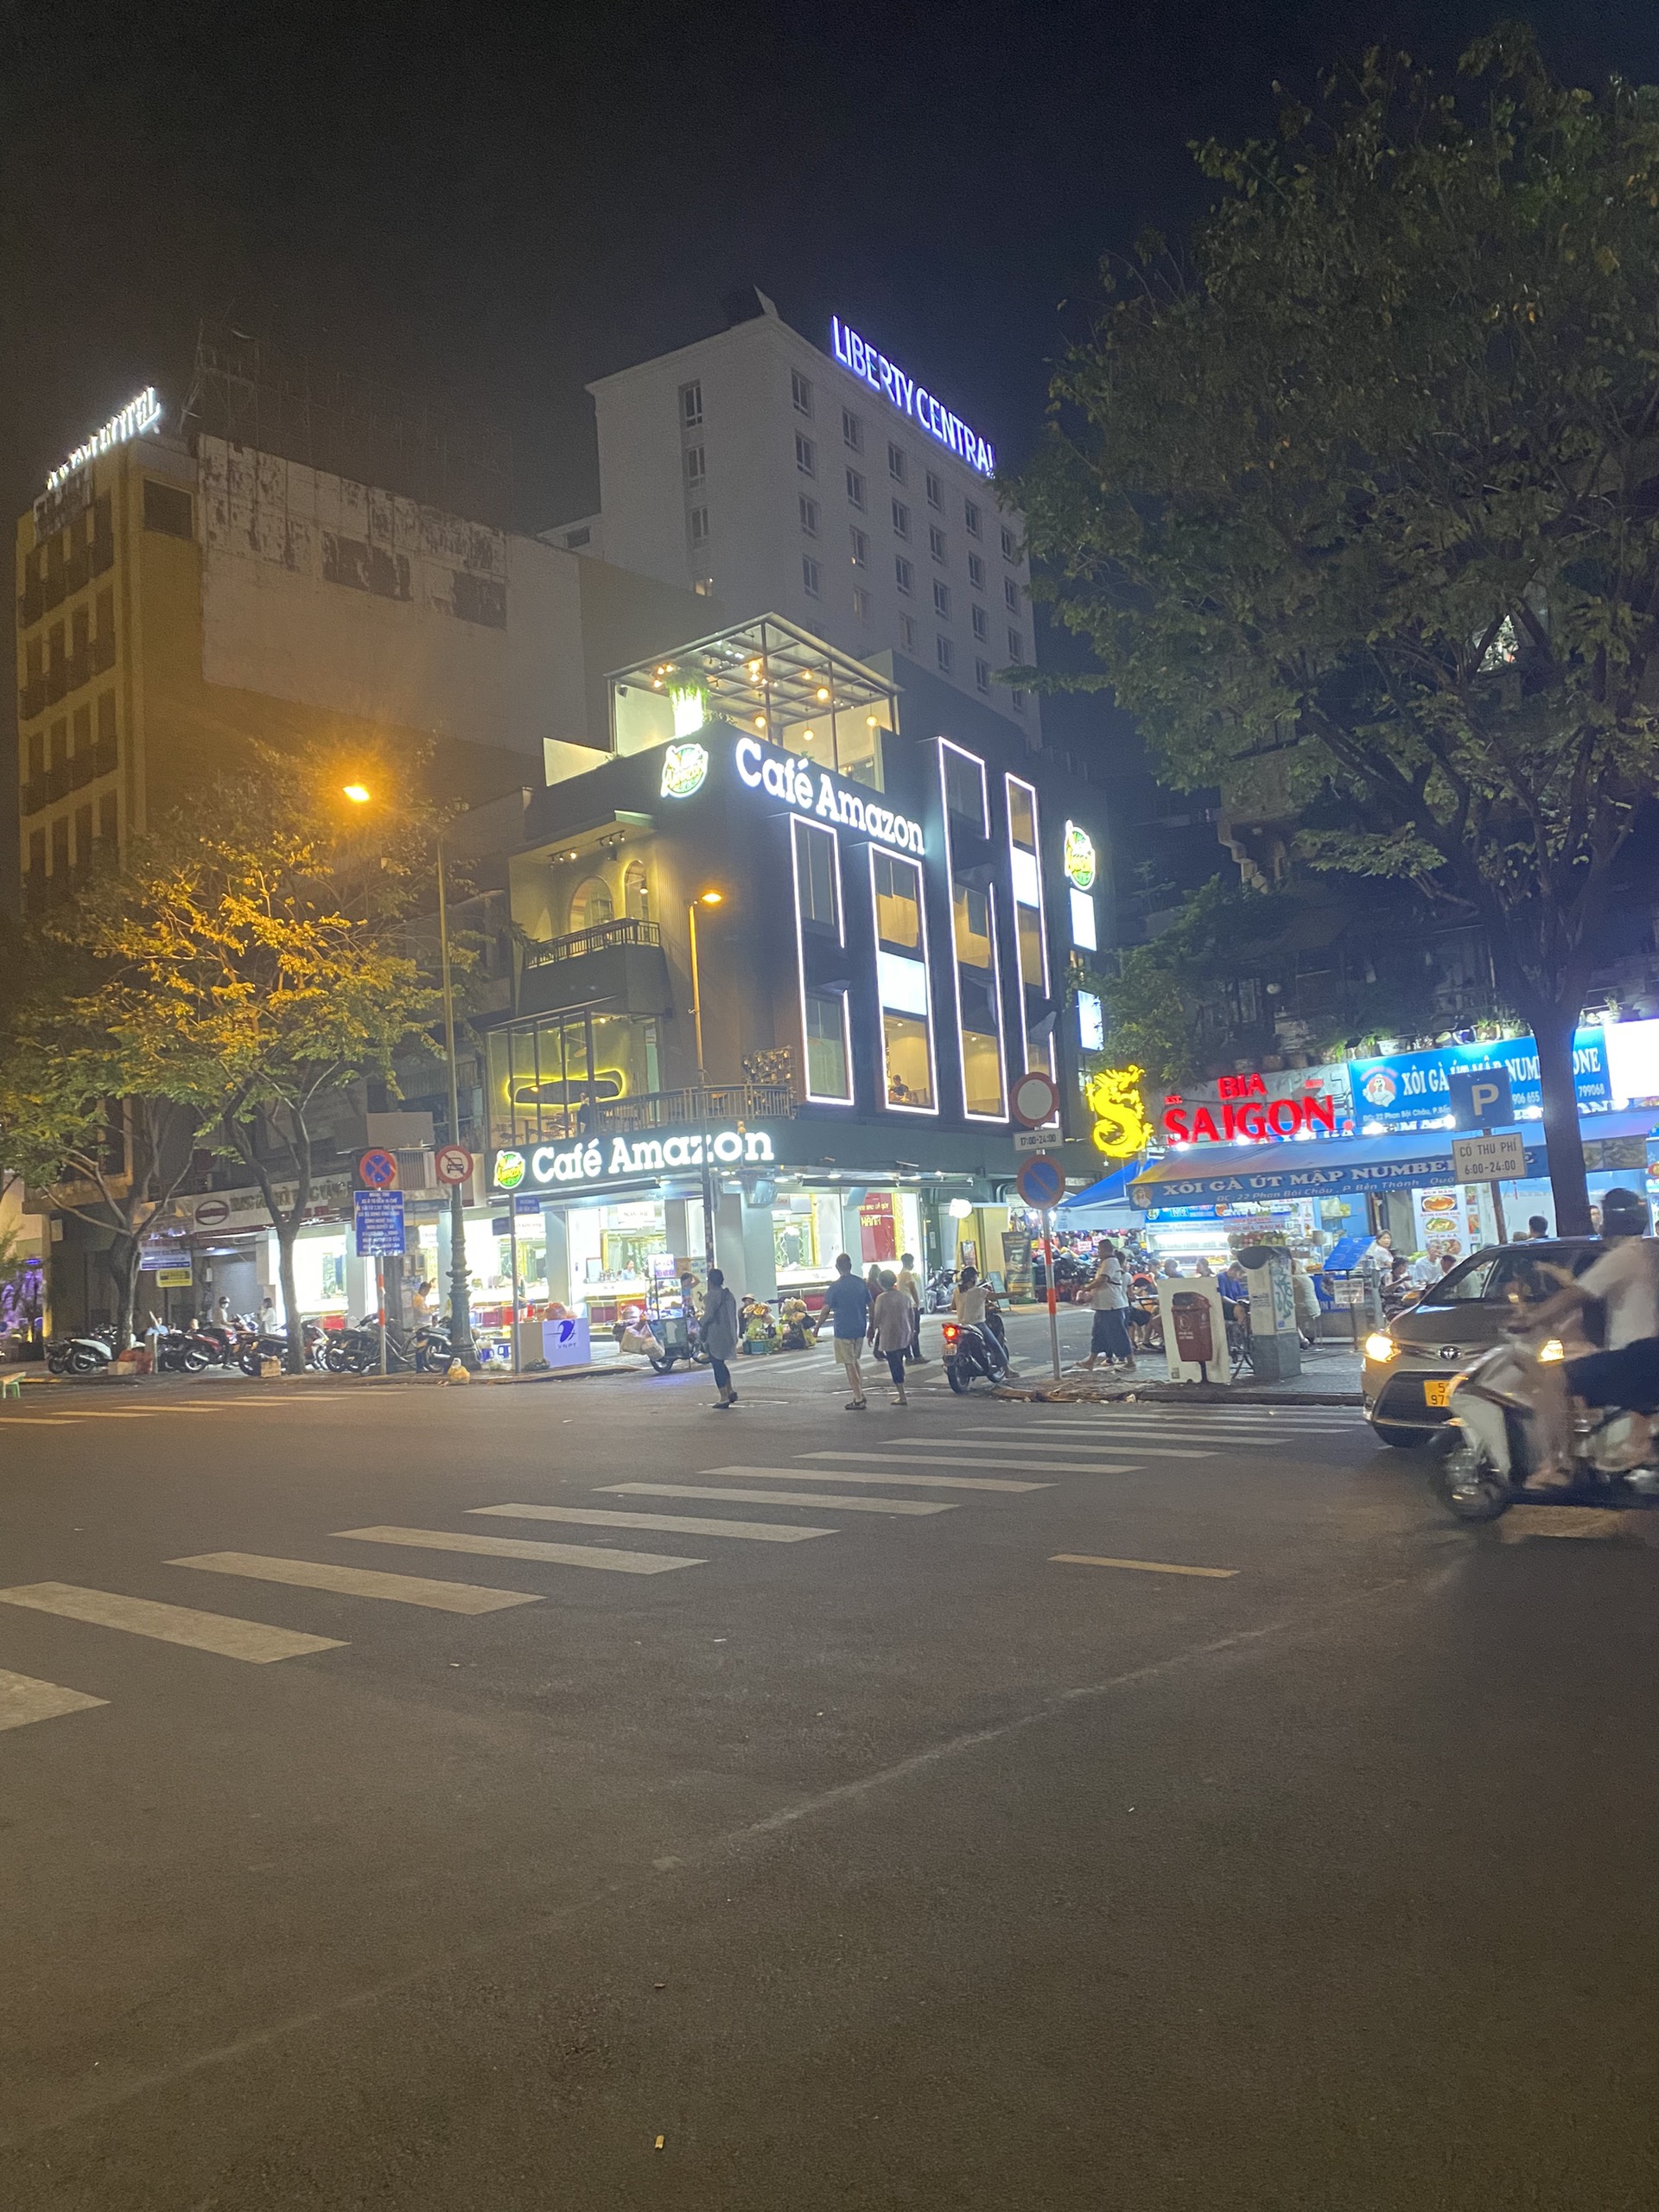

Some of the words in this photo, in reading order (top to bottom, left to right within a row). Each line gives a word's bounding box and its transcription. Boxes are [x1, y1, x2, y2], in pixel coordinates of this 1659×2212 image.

[831, 315, 914, 416] LIBERTY
[735, 737, 814, 809] Café
[816, 772, 925, 855] Amazon
[1217, 1072, 1268, 1100] BIA
[1401, 1065, 1427, 1096] XÔI
[1428, 1061, 1450, 1092] GÀ
[1471, 1084, 1499, 1116] P
[1163, 1094, 1335, 1146] SAIGON
[1020, 1134, 1057, 1146] 17:00-24:00
[1459, 1142, 1472, 1158] CÓ
[1478, 1142, 1496, 1156] THU
[1501, 1138, 1517, 1152] PHÍ
[531, 1138, 602, 1183] Café
[607, 1131, 774, 1174] Amazon
[1465, 1160, 1516, 1175] 6:00-24:00
[1163, 1181, 1203, 1196] XÔI
[1210, 1178, 1243, 1192] GÀ
[1250, 1175, 1282, 1188] ÚT
[1290, 1170, 1344, 1186] MẬP
